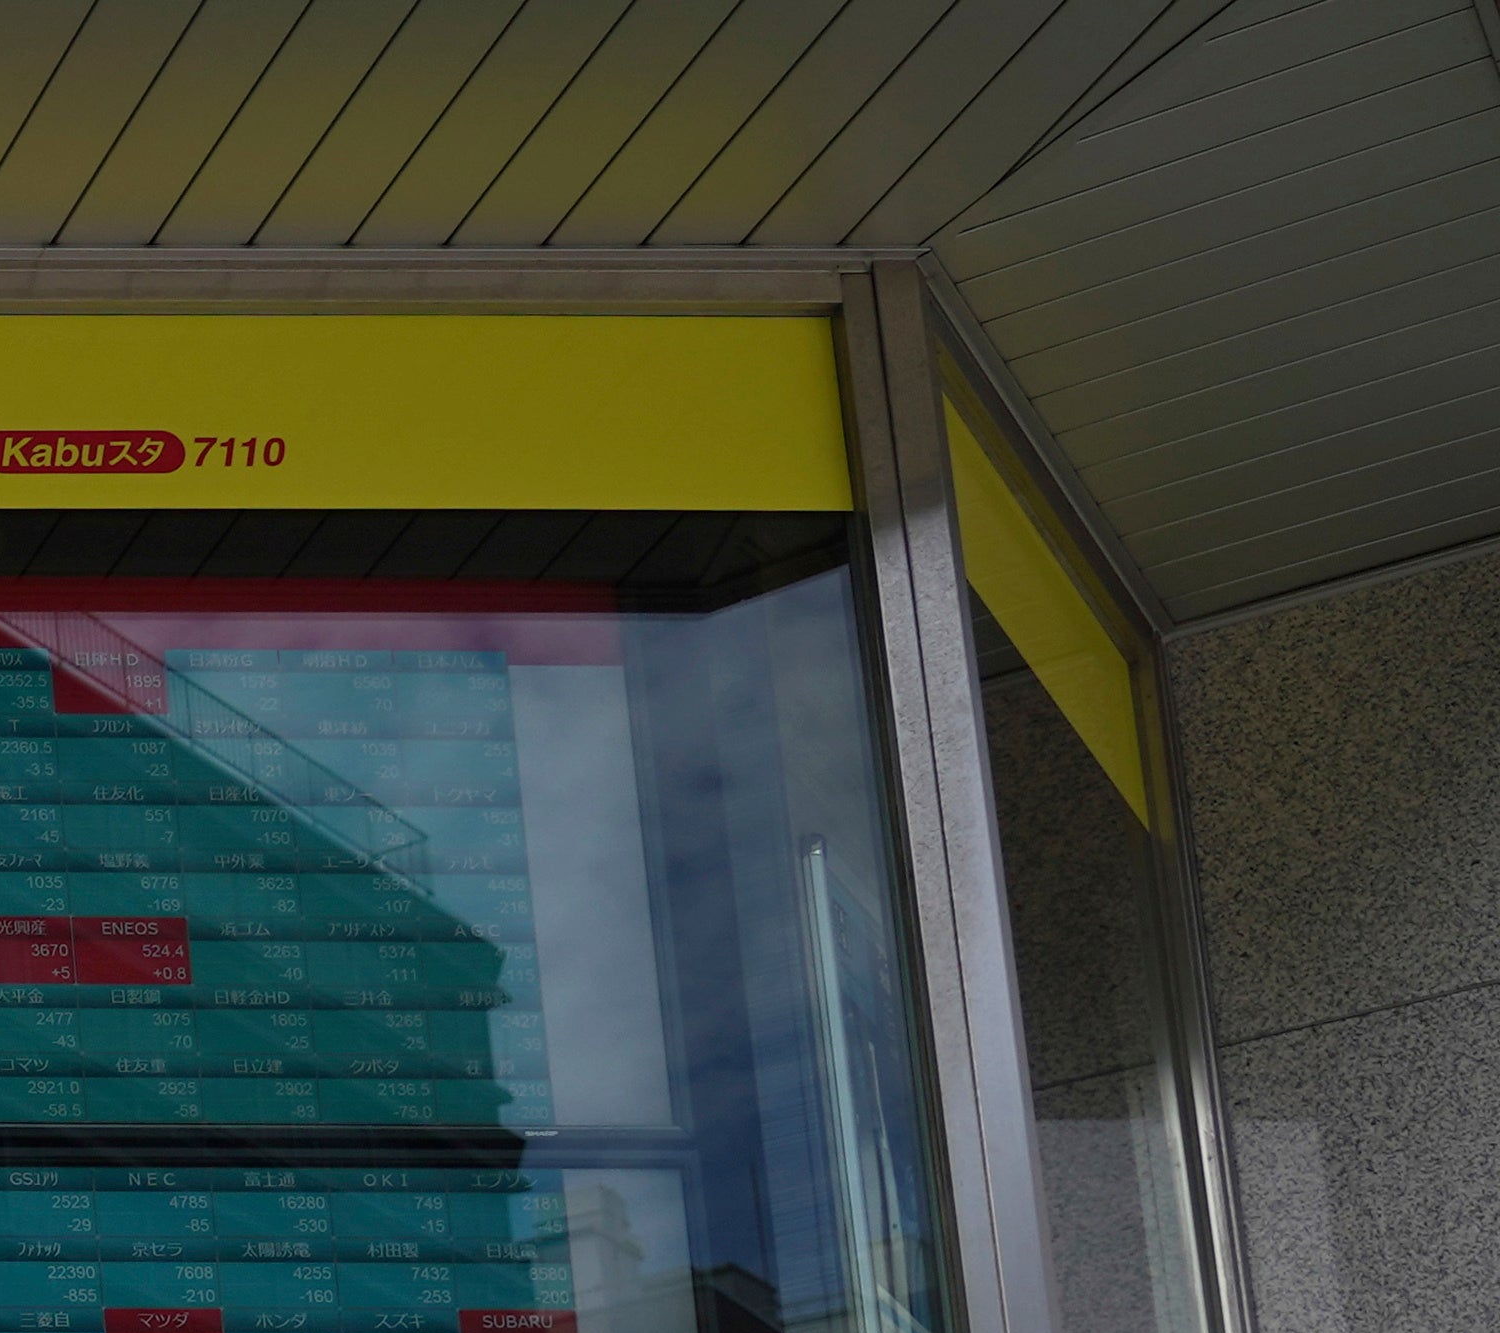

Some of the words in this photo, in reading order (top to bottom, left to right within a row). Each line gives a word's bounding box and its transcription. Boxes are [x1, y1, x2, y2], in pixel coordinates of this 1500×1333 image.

[2, 437, 165, 467] Kabuスタ
[194, 437, 286, 467] 7110
[100, 921, 159, 936] ENEOS
[30, 942, 69, 957] 3670
[141, 943, 185, 958] 524.4
[50, 965, 71, 980] +5
[152, 965, 187, 980] +0.8
[348, 1058, 400, 1075] クボタ
[26, 1078, 81, 1094] 2921.0
[375, 1079, 431, 1094] 2136.5
[41, 1102, 83, 1118] -58.5
[391, 1104, 434, 1121] -75.0
[136, 1311, 190, 1329] マツダ
[481, 1314, 554, 1329] SUBARU
